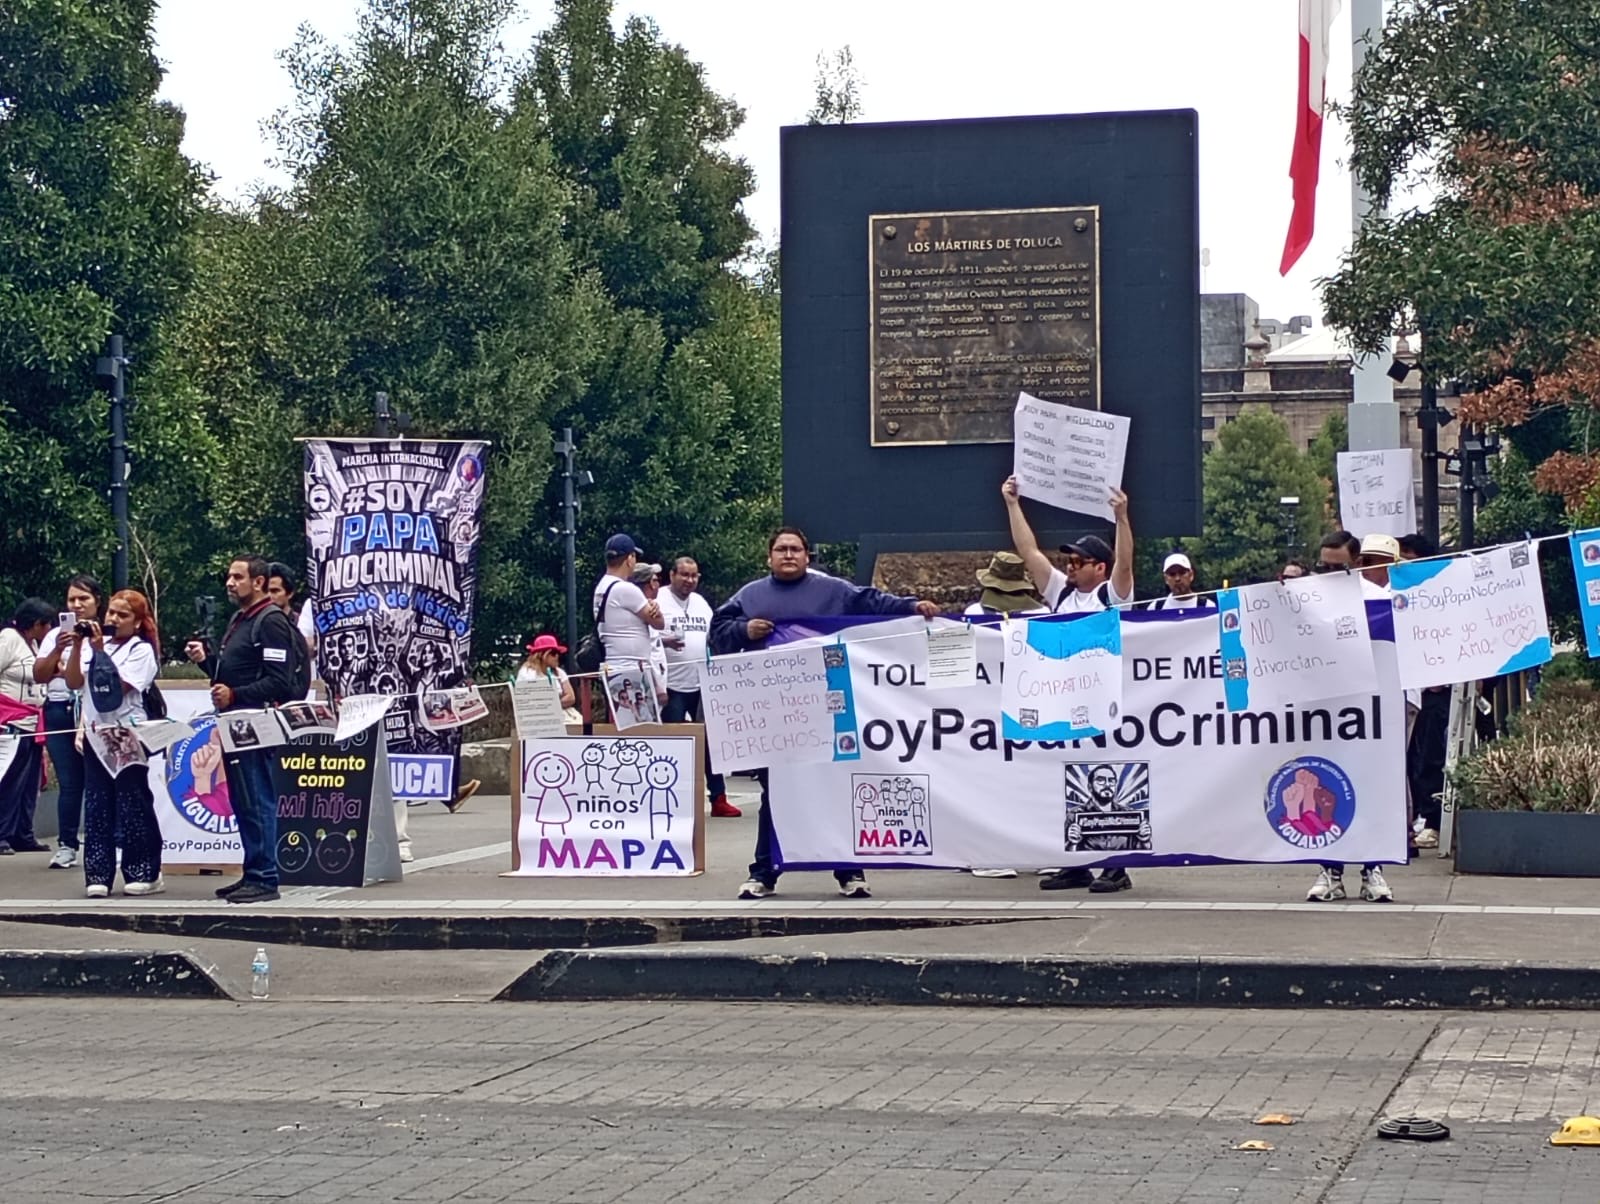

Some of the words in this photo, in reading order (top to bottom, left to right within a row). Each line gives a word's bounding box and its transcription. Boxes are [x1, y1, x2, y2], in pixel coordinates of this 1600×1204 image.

[907, 242, 930, 253] LOS
[935, 239, 993, 252] MÁRTIRES
[996, 239, 1012, 249] DE
[1015, 236, 1063, 249] TOLUCA
[891, 268, 901, 277] 19
[895, 381, 922, 390] Toluca
[342, 454, 379, 468] MARCHA
[381, 452, 445, 469] INTERNACIONAL
[343, 481, 428, 514] #SOY
[323, 551, 461, 602] NOCRIMINAL
[316, 591, 378, 633] Estado
[386, 588, 409, 608] de
[1245, 592, 1271, 613] Los
[1278, 590, 1322, 614] hijos
[1250, 619, 1274, 646] NO
[1461, 621, 1477, 643] yo
[1485, 603, 1534, 627] también
[732, 661, 755, 678] que
[763, 654, 807, 670] cumplo
[1132, 657, 1172, 682] DE
[1424, 651, 1446, 667] los
[867, 661, 992, 686] TOLA
[709, 682, 728, 694] con
[735, 678, 756, 690] mis
[710, 698, 744, 718] Pero
[752, 699, 772, 711] me
[780, 690, 819, 707] hacen
[783, 710, 809, 725] mis
[280, 752, 317, 771] vale
[320, 754, 366, 772] tanto
[297, 774, 345, 789] como
[390, 761, 444, 795] UCA
[181, 796, 239, 834] IGUALD
[276, 791, 307, 818] Mi
[312, 792, 362, 825] hija
[576, 795, 639, 814] niños
[589, 819, 625, 830] con
[883, 817, 904, 827] con
[858, 829, 929, 848] MAPA
[1278, 822, 1341, 848] IGUALDAD
[537, 837, 686, 870] MAPA
